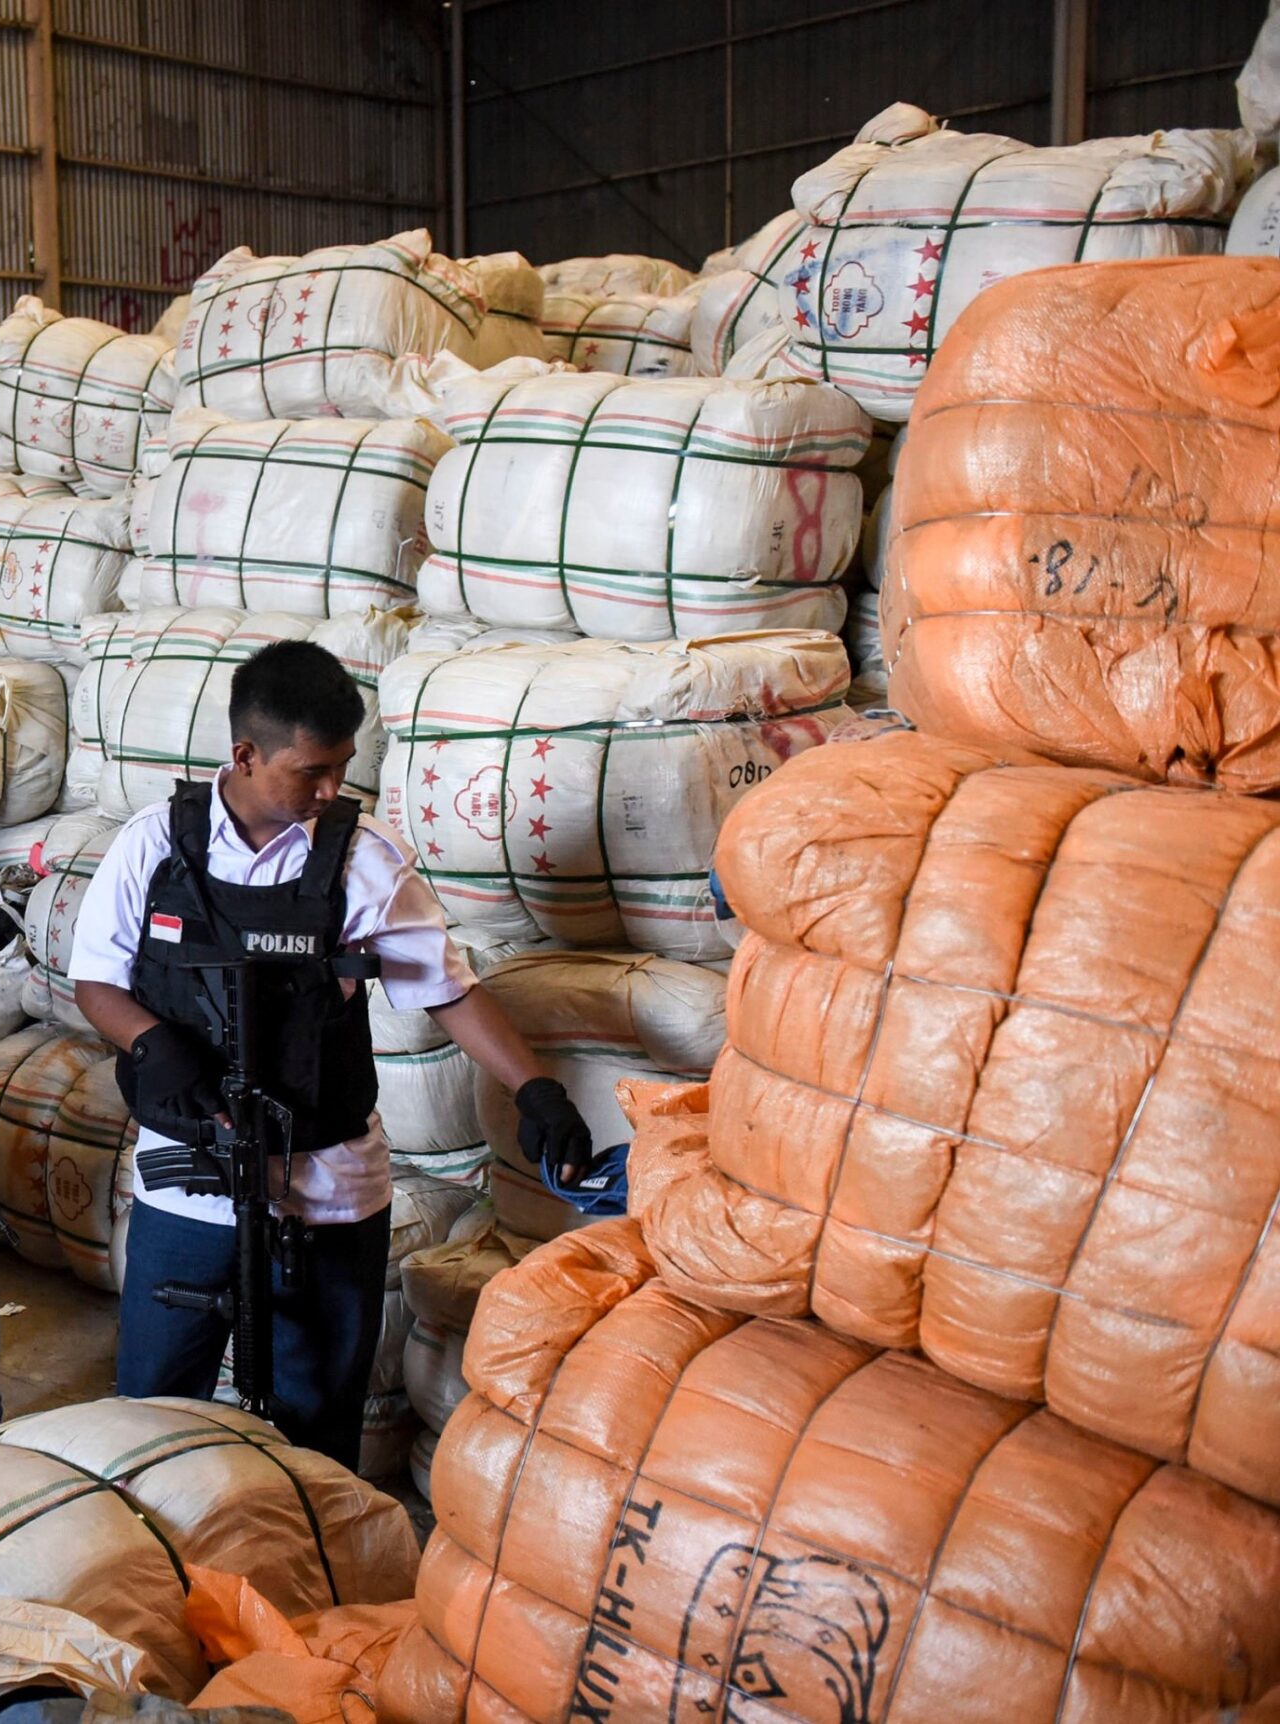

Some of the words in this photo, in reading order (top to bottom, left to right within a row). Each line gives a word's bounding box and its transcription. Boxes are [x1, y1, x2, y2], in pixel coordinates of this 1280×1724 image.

[832, 288, 840, 312] TOKO
[842, 288, 852, 313] HONG
[857, 288, 867, 313] YANG
[246, 933, 316, 955] POLISI
